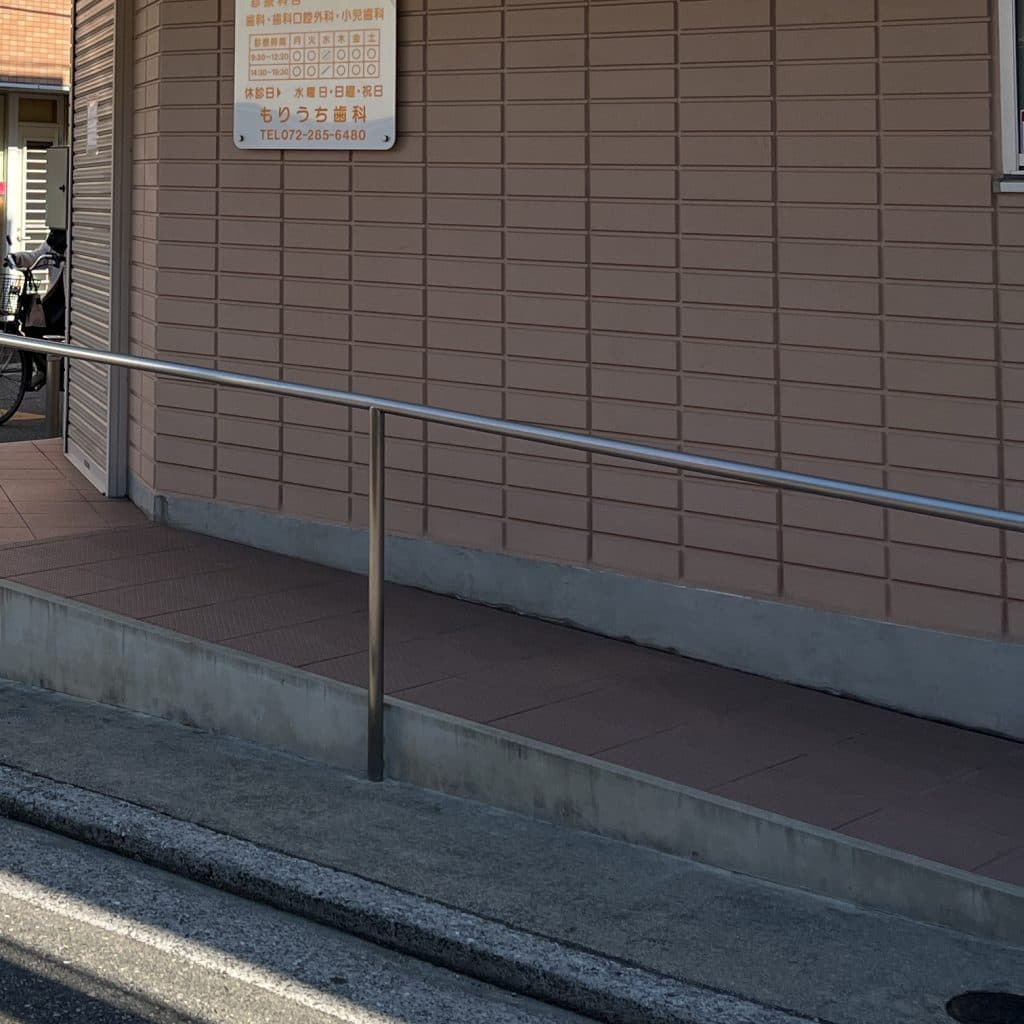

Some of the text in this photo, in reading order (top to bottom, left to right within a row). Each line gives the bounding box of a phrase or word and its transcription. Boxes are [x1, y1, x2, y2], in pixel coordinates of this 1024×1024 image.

[260, 105, 367, 124] もりうち歯科
